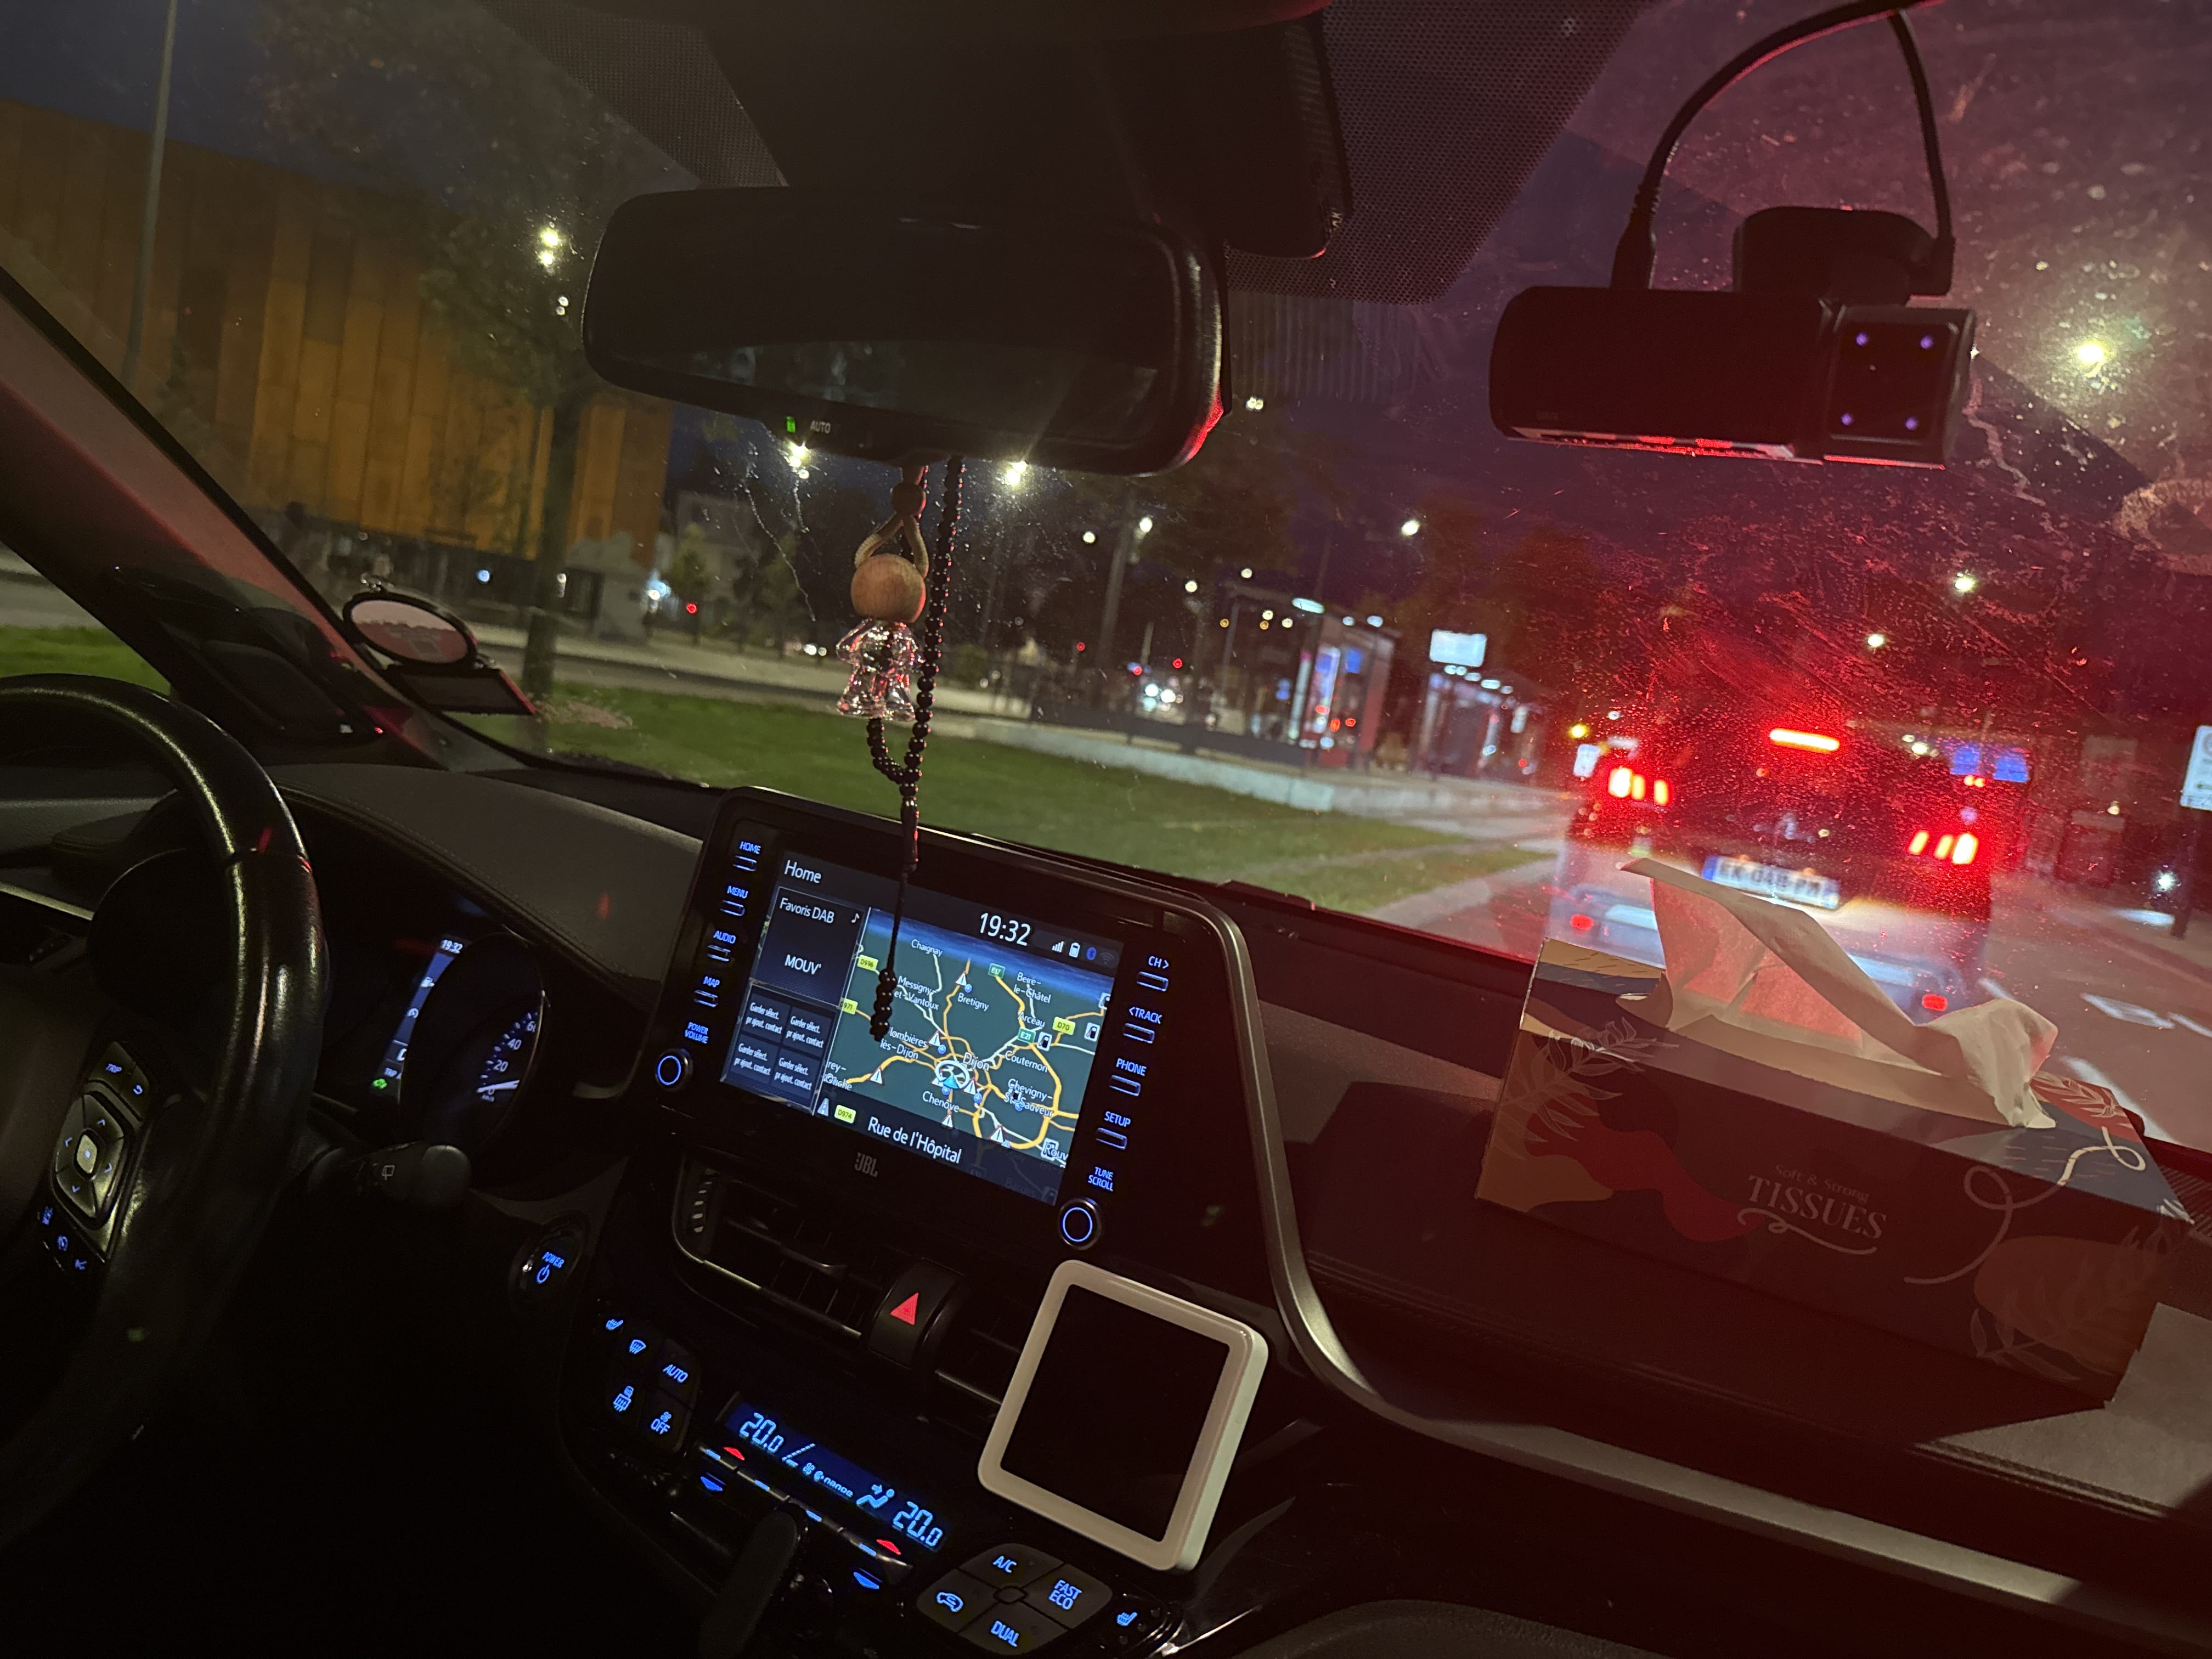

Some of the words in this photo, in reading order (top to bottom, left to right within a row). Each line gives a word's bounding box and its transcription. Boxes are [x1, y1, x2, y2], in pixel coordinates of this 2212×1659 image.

[810, 420, 831, 434] AUTO
[740, 841, 761, 854] HOME
[784, 860, 821, 883] Home
[727, 885, 748, 899] MENU
[780, 898, 811, 918] Favoris
[812, 907, 834, 924] DAB
[714, 930, 736, 944] AUDIO
[979, 912, 1031, 946] 19:32
[441, 939, 463, 953] 19:32
[911, 939, 943, 956] Chaignay
[785, 955, 821, 975] MOUV'
[860, 958, 874, 968] D996
[703, 976, 720, 988] MAP
[1017, 972, 1041, 985] Beire-
[894, 990, 939, 1011] et-Vantoux
[957, 992, 990, 1011] Bretigny
[1014, 984, 1051, 1003] le-Châtel
[751, 1002, 767, 1015] Garder
[527, 1021, 536, 1032] 6
[688, 1022, 708, 1035] POWER
[765, 1023, 782, 1034] contact
[791, 1016, 806, 1029] Garder
[1018, 1012, 1045, 1028] Arceau
[1057, 1022, 1070, 1031] D70
[508, 1039, 522, 1050] 40
[685, 1029, 708, 1043] VOLUME
[806, 1036, 823, 1048] contact
[889, 1027, 927, 1047] lombières
[738, 1043, 755, 1056] Garder
[494, 1060, 509, 1073] 20
[754, 1064, 771, 1075] contact
[779, 1058, 795, 1070] Garder
[963, 1052, 990, 1071] Dijon
[1005, 1051, 1047, 1073] Couternon
[1116, 1058, 1147, 1076] PHONE
[794, 1078, 812, 1090] contact
[923, 1091, 960, 1113] Chenôve
[837, 1109, 853, 1119] D974
[1104, 1111, 1131, 1127] SETUP
[868, 1116, 890, 1138] Rue
[893, 1127, 908, 1144] de
[910, 1131, 962, 1164] l'Hôpital
[854, 1153, 878, 1177] JBL
[1094, 1167, 1113, 1180] TUNE
[1088, 1175, 1114, 1192] SCROLL
[1775, 1164, 1803, 1182] Soft
[1807, 1175, 1818, 1186] &
[1824, 1178, 1870, 1203] Strong
[1748, 1175, 1887, 1239] TISSUES
[541, 1251, 565, 1268] POWER
[663, 1364, 689, 1384] AUTO
[651, 1418, 670, 1435] OFF
[739, 1412, 784, 1454] 20.0
[893, 1500, 943, 1547] 20.0
[992, 1555, 1017, 1574] A/C
[1053, 1579, 1082, 1599] FAST
[1048, 1589, 1074, 1610] ECO
[990, 1620, 1019, 1647] DUAL
